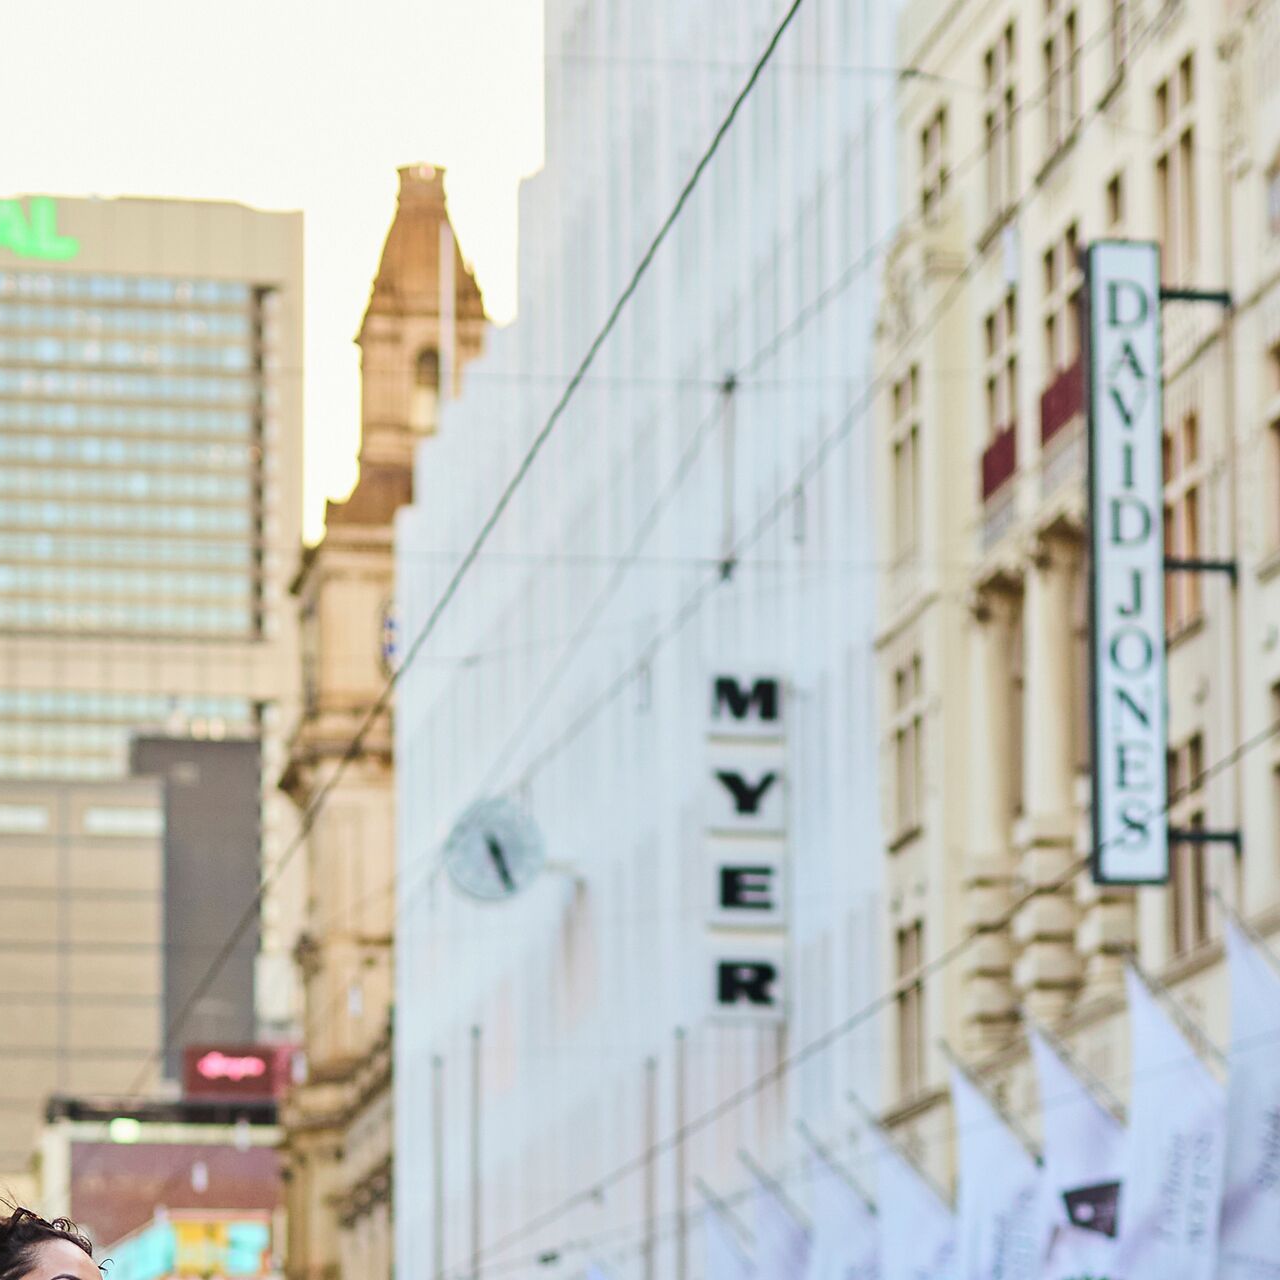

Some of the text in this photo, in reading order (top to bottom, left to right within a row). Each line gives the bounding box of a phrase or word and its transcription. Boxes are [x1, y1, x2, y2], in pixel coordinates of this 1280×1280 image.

[1106, 280, 1153, 852] DAVID JONES
[713, 674, 779, 1006] MYER
